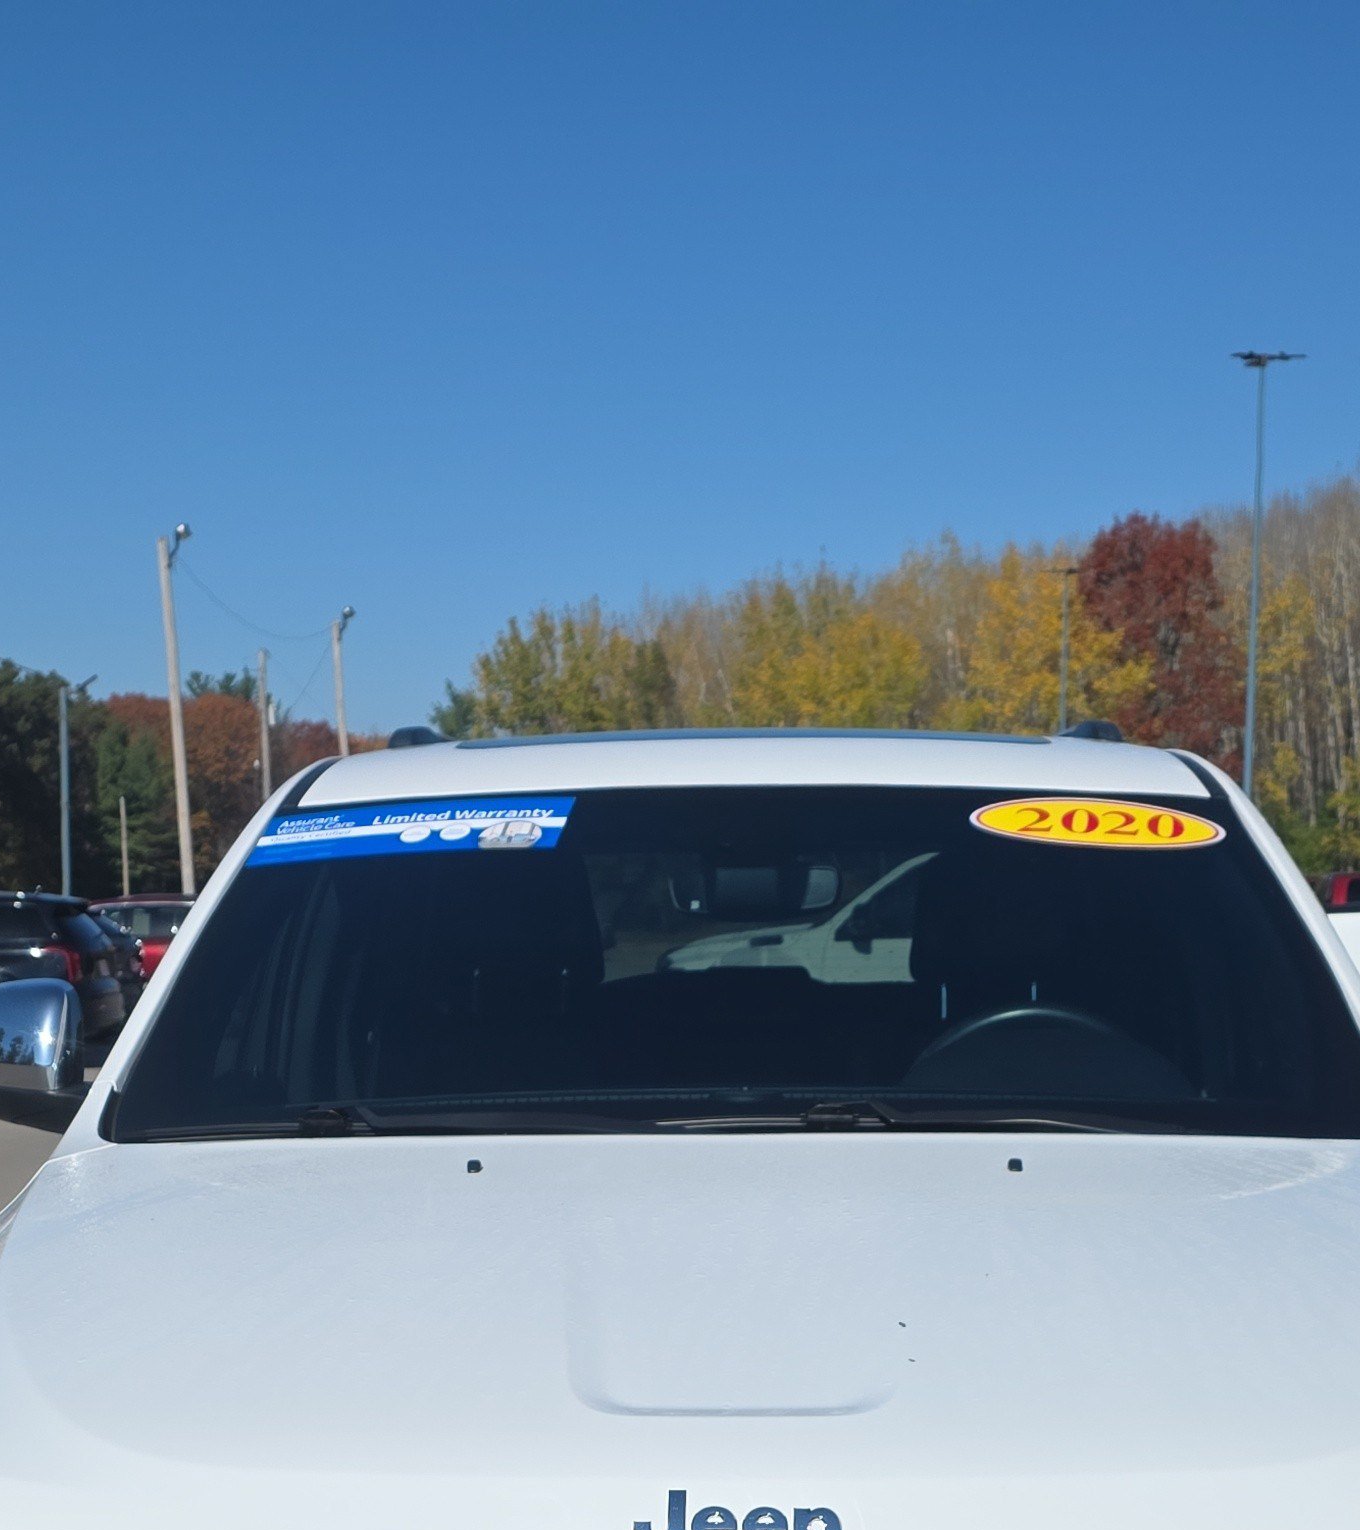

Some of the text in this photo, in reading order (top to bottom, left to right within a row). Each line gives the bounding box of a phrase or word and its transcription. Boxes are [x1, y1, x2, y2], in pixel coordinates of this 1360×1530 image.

[279, 815, 341, 828] Assurant
[371, 807, 555, 826] Limited Warranty
[1015, 806, 1185, 839] 2020
[276, 821, 356, 835] Vehicle Care
